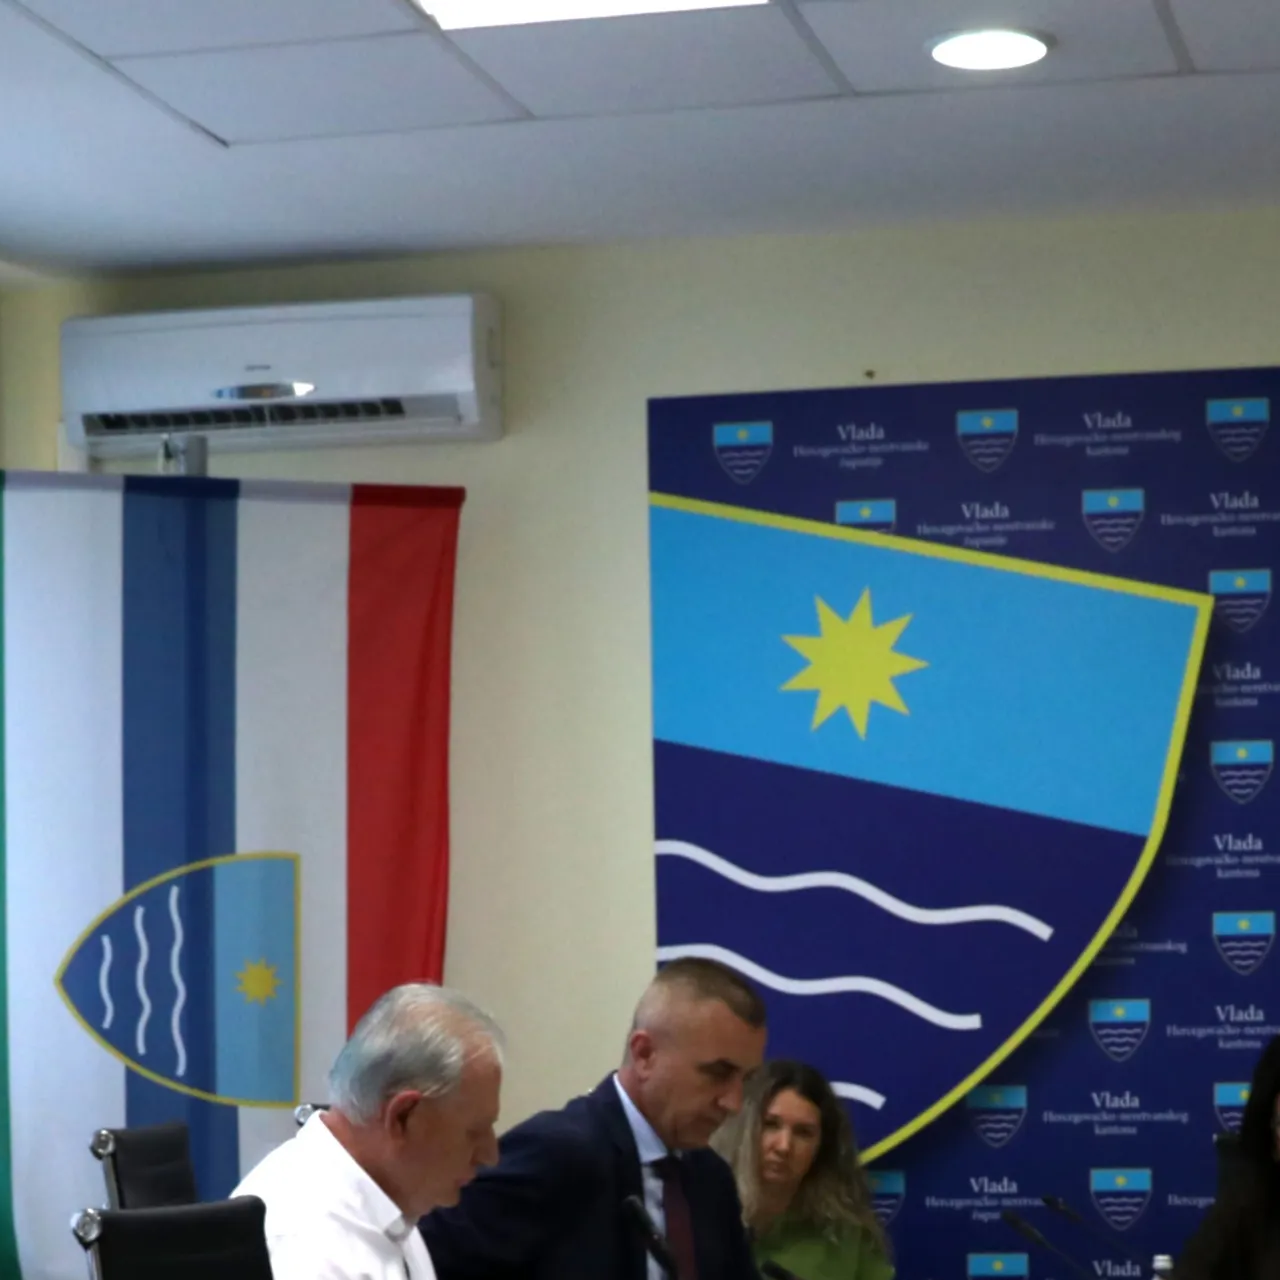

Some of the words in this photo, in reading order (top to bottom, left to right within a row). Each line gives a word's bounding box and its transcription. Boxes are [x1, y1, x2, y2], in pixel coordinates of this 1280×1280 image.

[1083, 411, 1132, 429] Vlada
[837, 422, 885, 441] Vlada
[1210, 490, 1259, 509] Vlada
[961, 501, 1010, 519] Vlada
[1213, 833, 1264, 852] Vlada
[1215, 1004, 1265, 1023] Vlada
[1090, 1090, 1140, 1109] Vlada
[970, 1176, 1018, 1194] Vlada
[1092, 1260, 1140, 1278] Vlada
